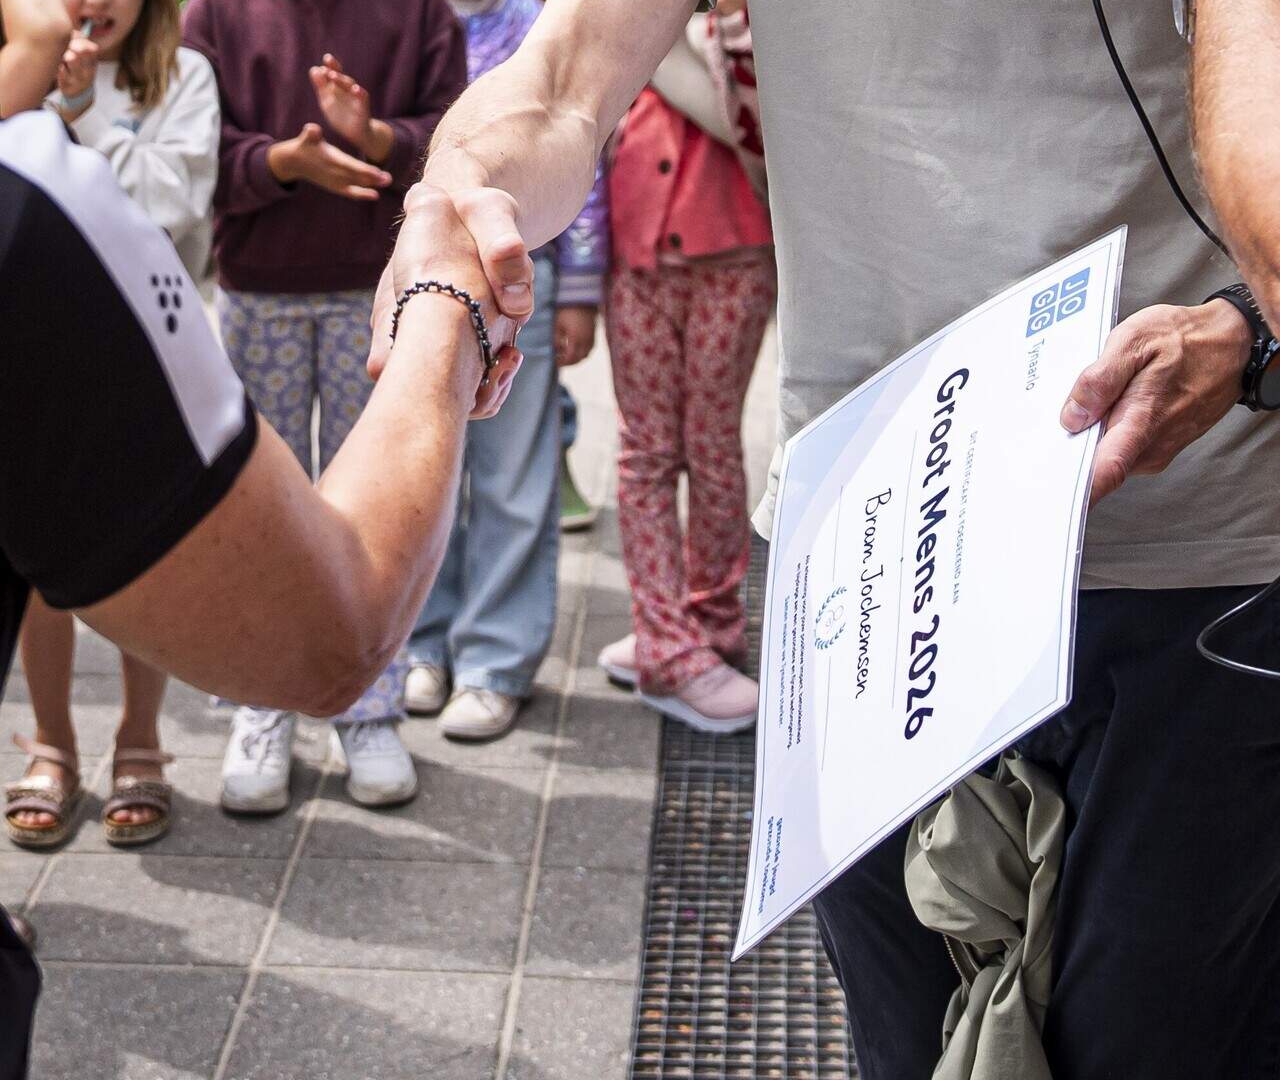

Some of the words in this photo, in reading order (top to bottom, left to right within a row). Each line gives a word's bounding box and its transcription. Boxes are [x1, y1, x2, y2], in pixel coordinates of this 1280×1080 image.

[1025, 338, 1045, 391] Tynaarlo
[922, 368, 970, 488] Groot
[862, 488, 892, 564] Bram
[913, 485, 950, 614] Mens
[855, 564, 884, 700] Jochemsen
[904, 614, 940, 740] 2026
